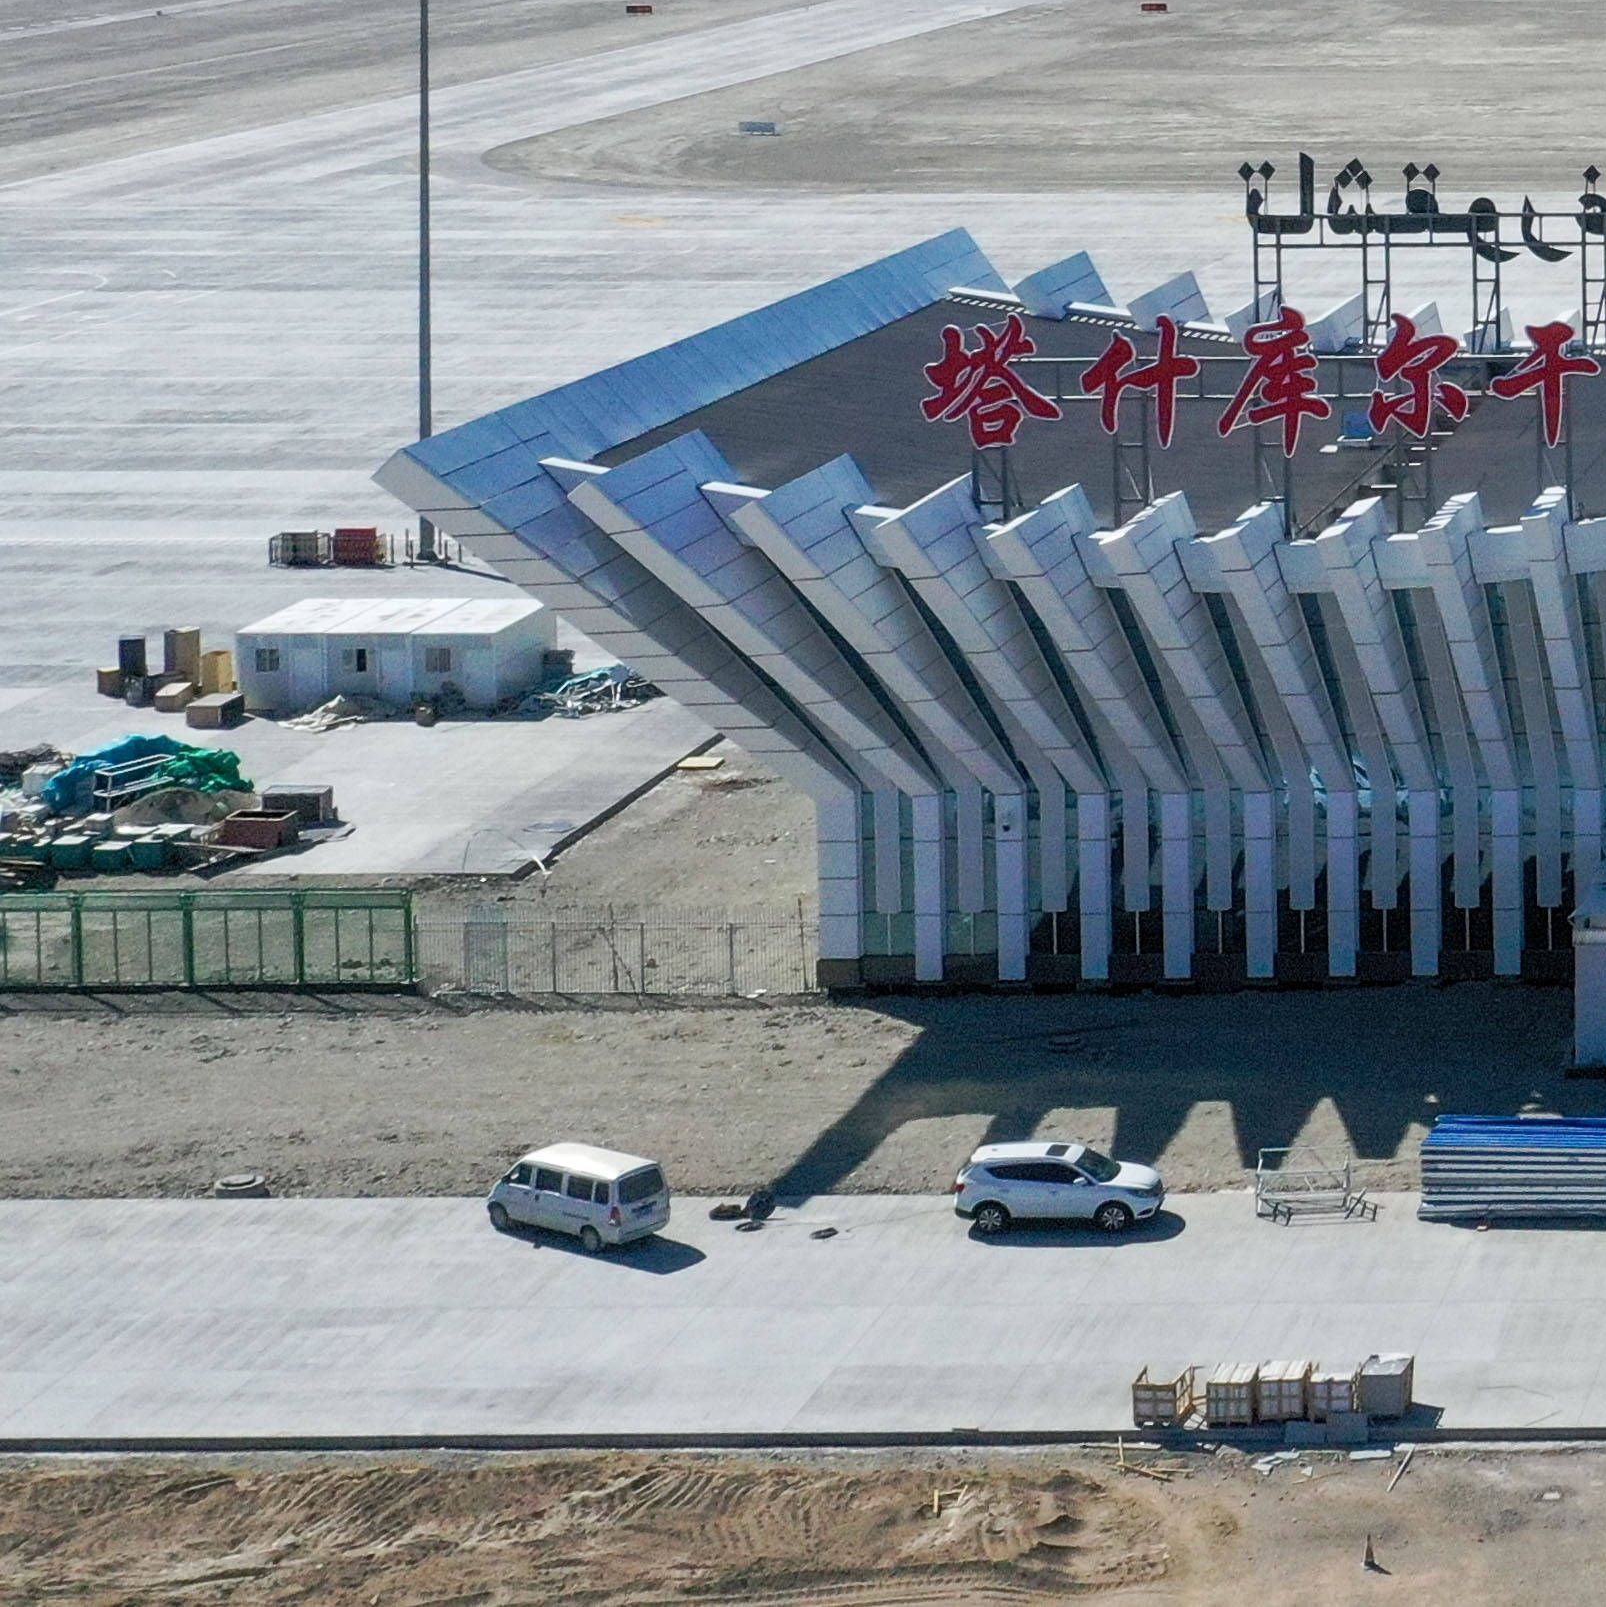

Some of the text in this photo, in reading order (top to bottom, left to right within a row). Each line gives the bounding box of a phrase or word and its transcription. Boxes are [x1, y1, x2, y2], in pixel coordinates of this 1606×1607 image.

[919, 305, 1602, 459] 塔什库尔干
